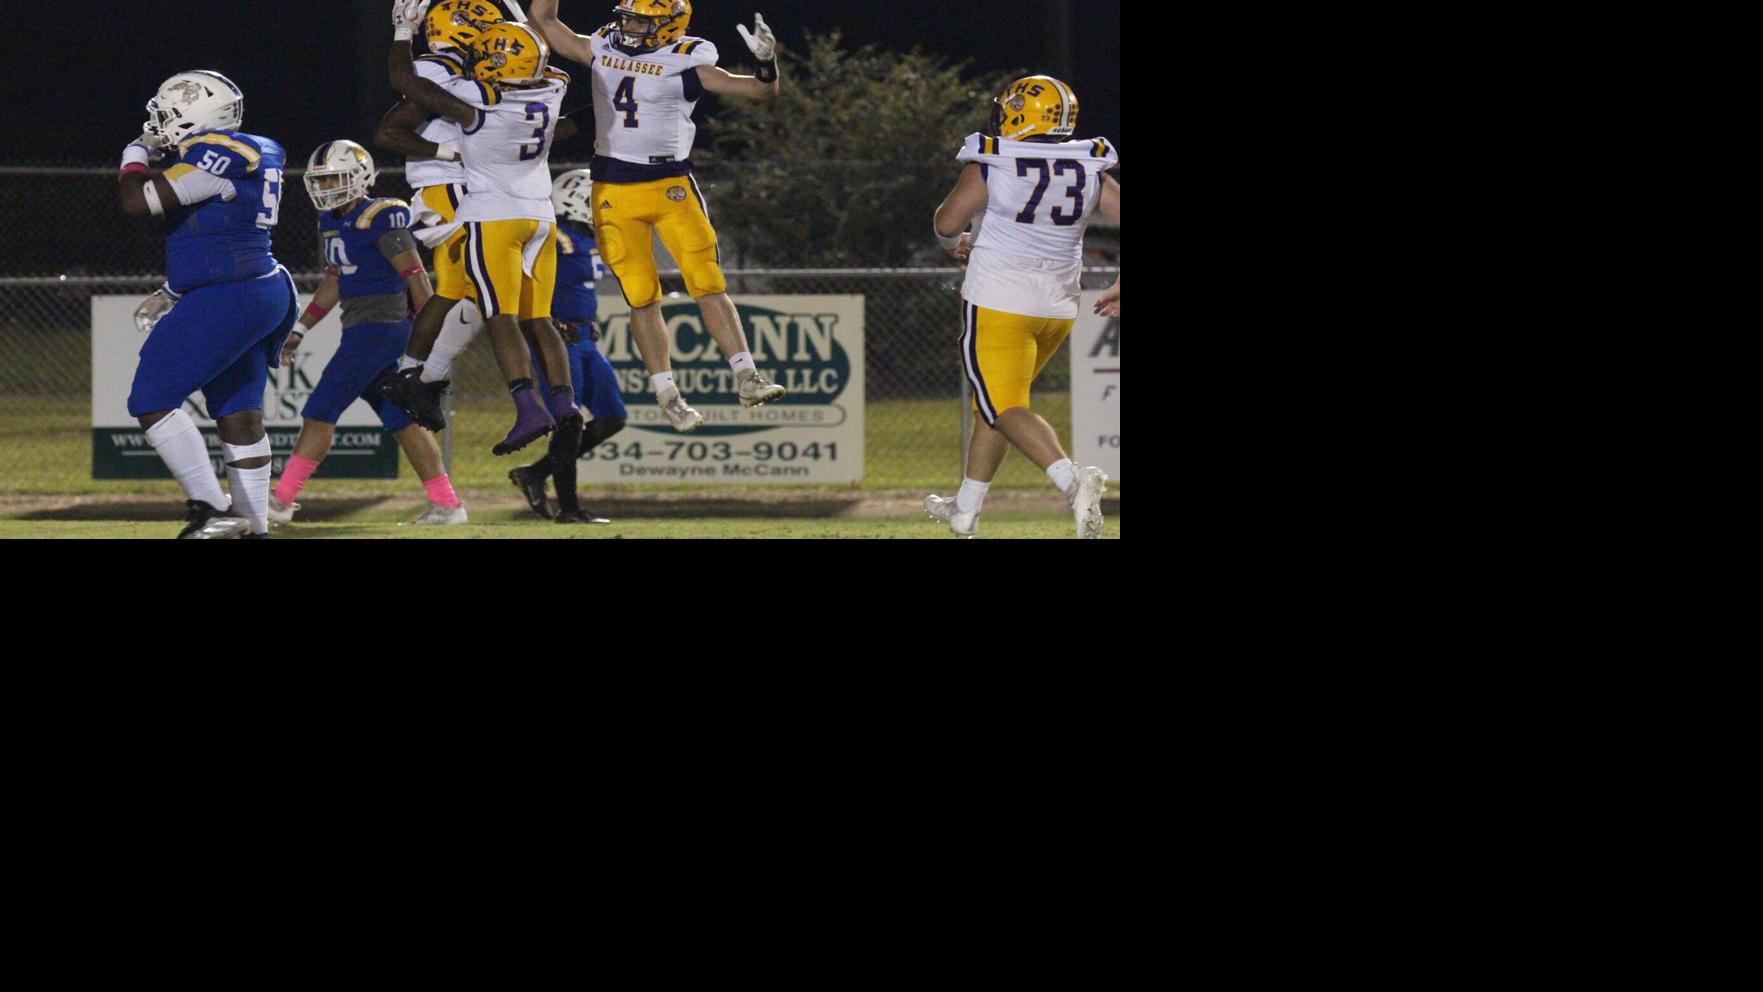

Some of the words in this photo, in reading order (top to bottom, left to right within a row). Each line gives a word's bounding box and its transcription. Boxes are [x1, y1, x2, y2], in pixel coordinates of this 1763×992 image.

[481, 37, 525, 56] THS
[601, 54, 663, 77] TALLASSEE
[612, 75, 639, 128] 4
[519, 101, 550, 161] 3
[196, 149, 232, 176] 50
[1014, 157, 1087, 226] 73
[388, 212, 406, 229] 10
[785, 368, 840, 394] LLC
[619, 464, 716, 479] Dewayne
[722, 463, 809, 477] McCann
